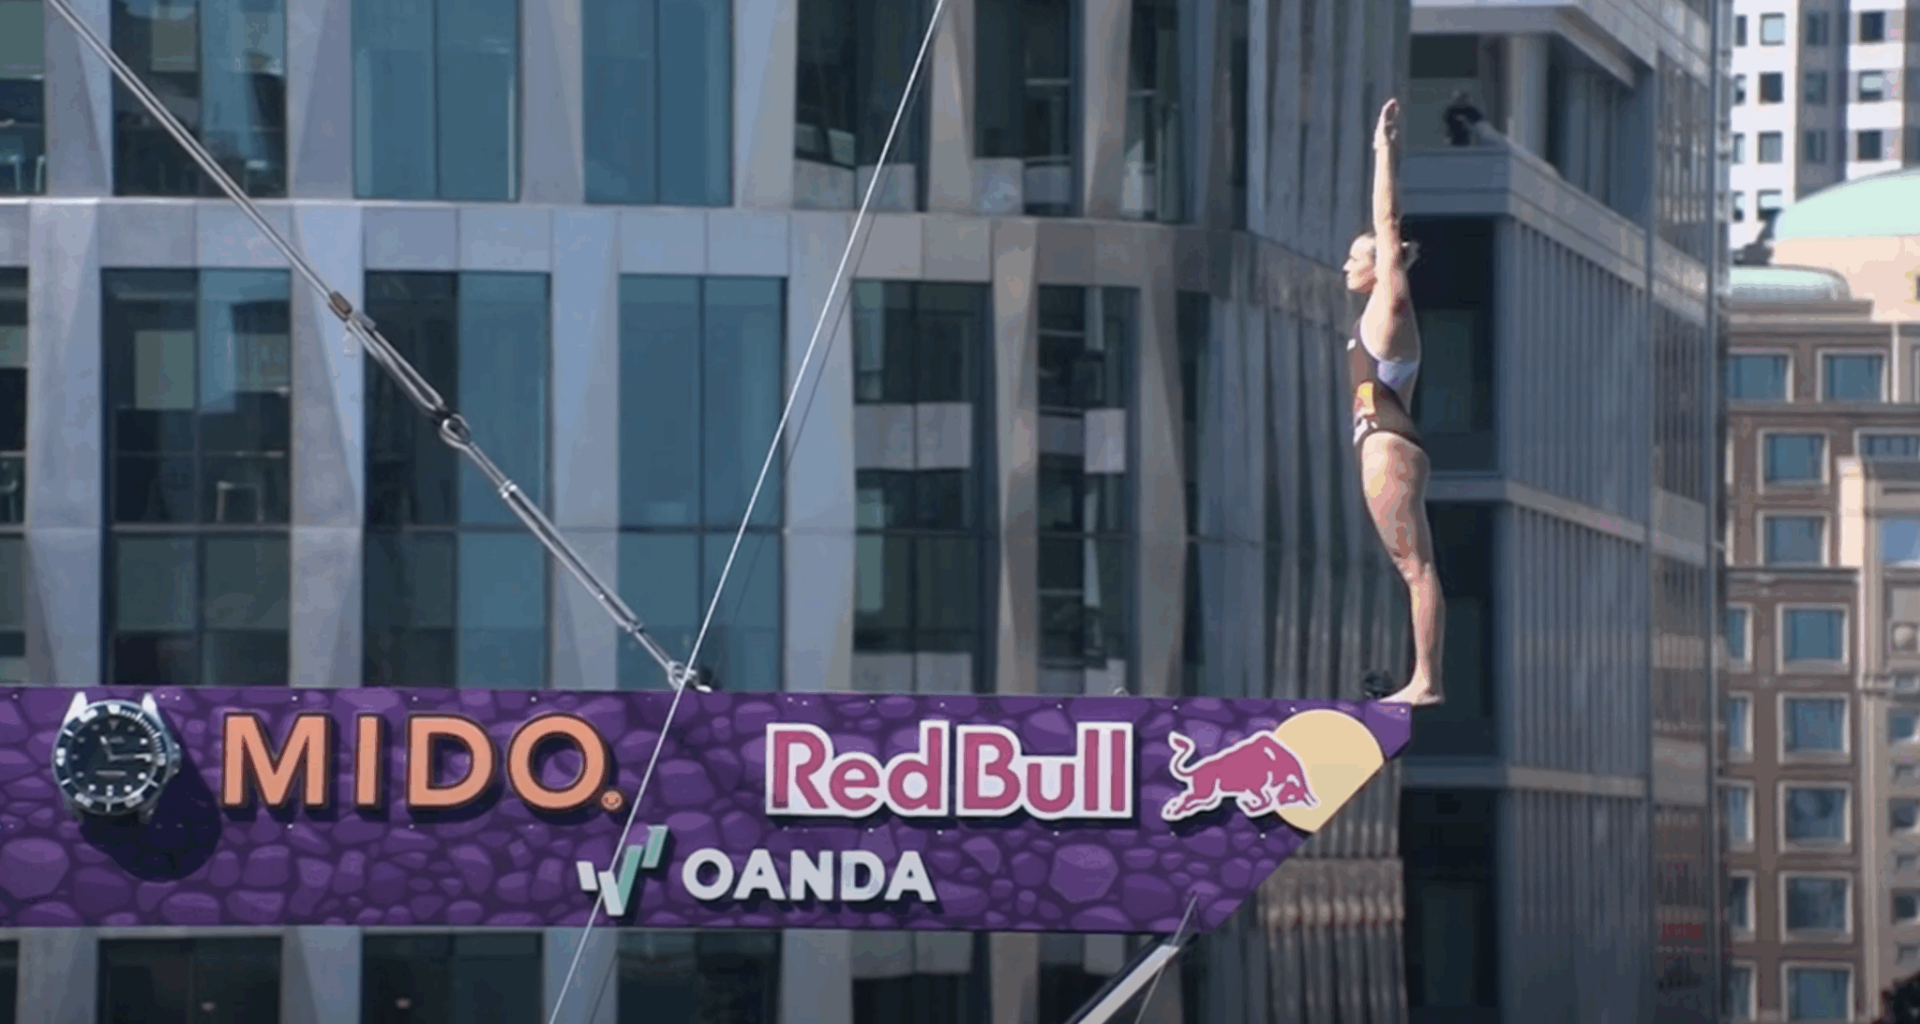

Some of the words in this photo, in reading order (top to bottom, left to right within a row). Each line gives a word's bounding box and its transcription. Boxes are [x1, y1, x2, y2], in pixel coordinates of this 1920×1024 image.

[222, 713, 607, 808] MIDO
[770, 724, 944, 814] Red
[960, 724, 1128, 815] Bull
[682, 848, 937, 902] OANDA
